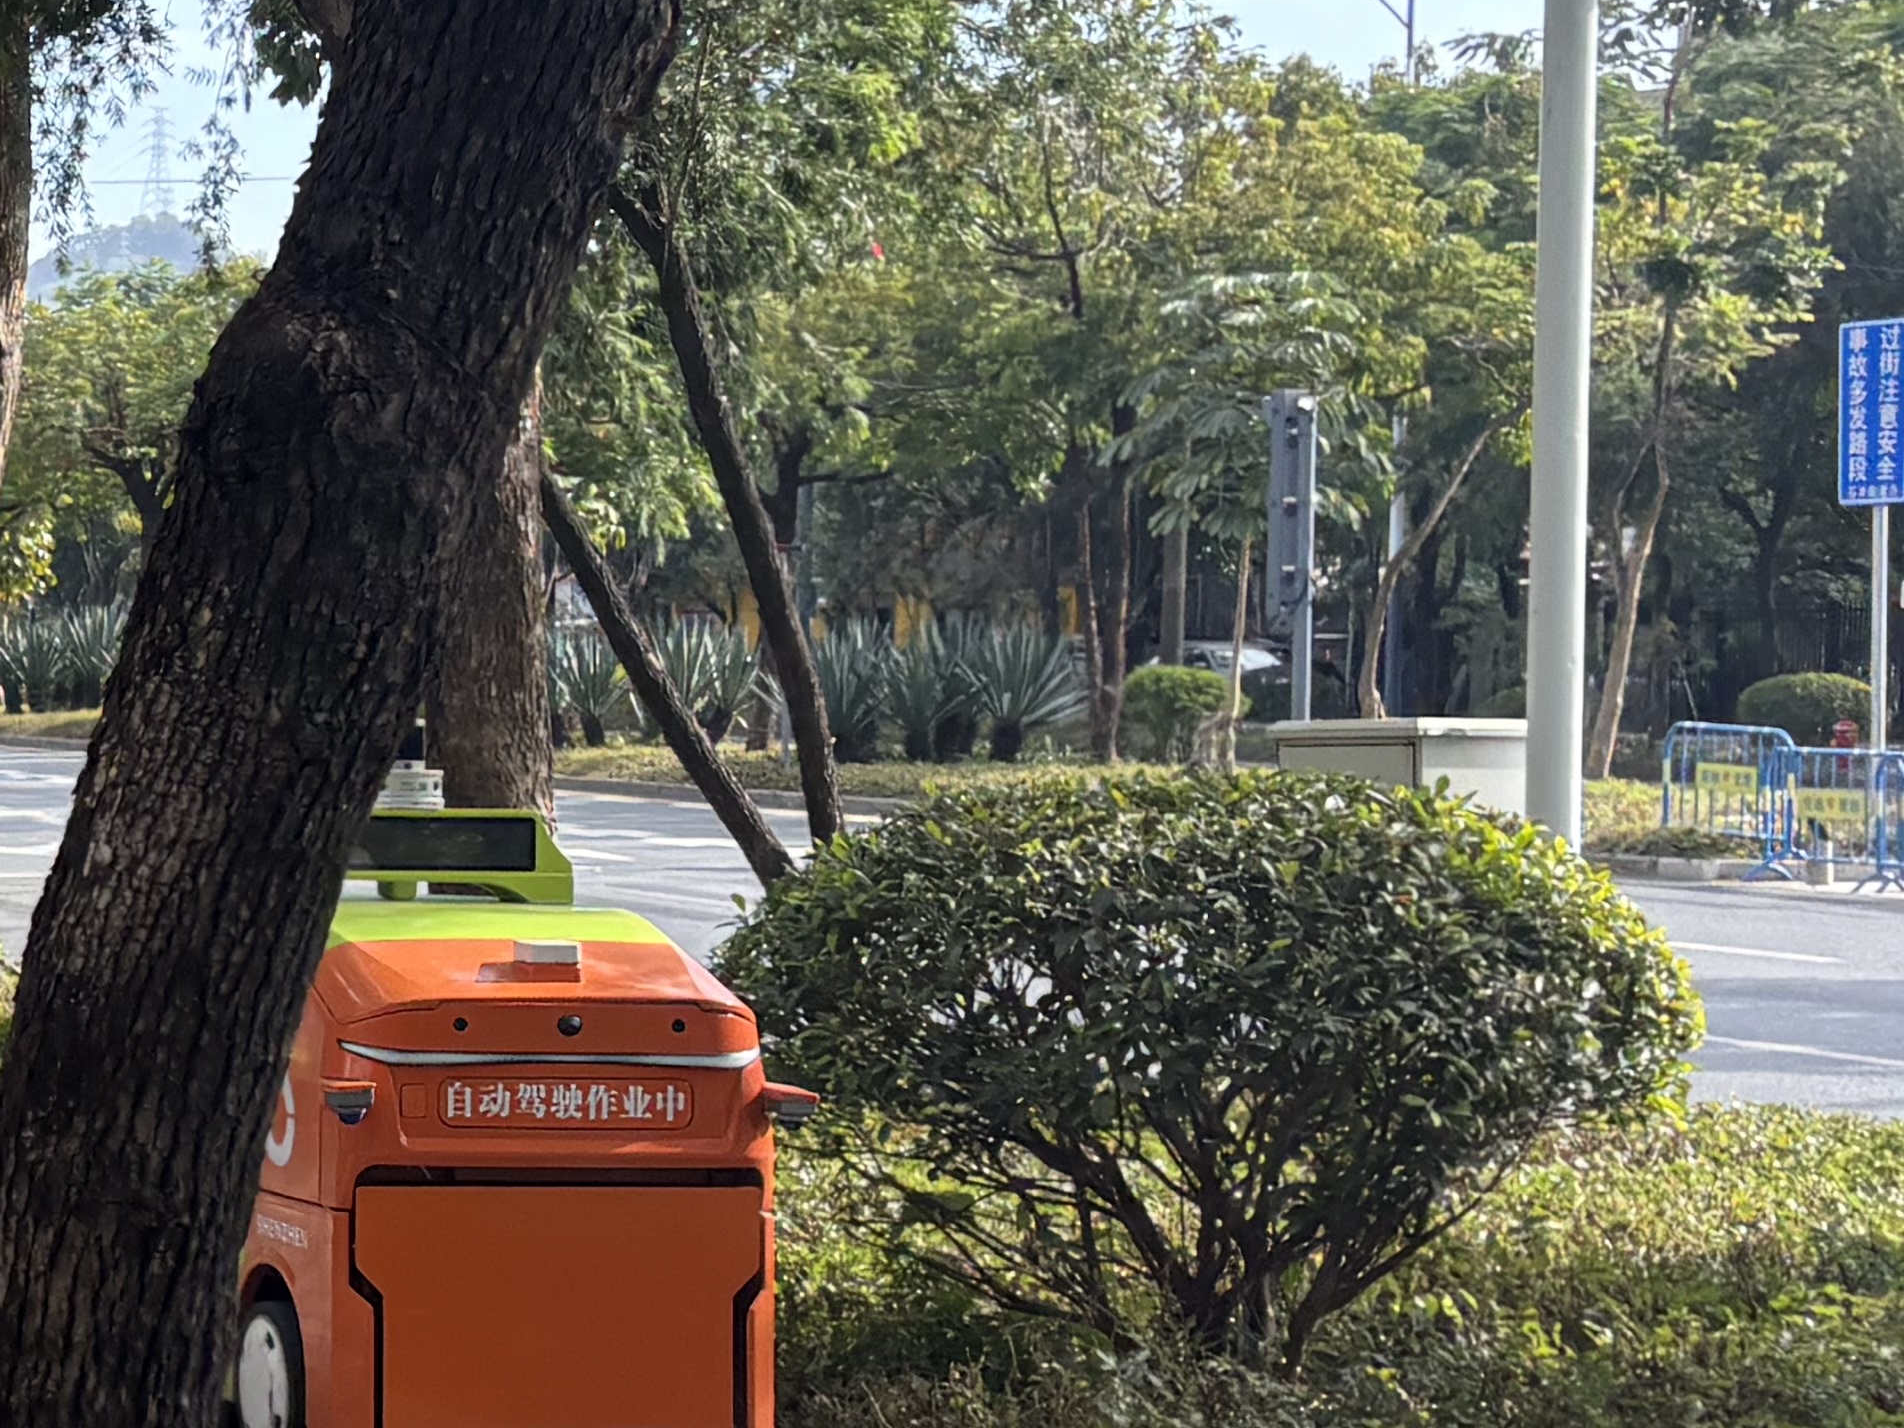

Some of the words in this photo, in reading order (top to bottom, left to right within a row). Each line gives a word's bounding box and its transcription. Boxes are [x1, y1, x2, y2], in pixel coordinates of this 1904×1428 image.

[1848, 327, 1868, 483] 事故多发路段
[1876, 324, 1901, 481] 过街注意安全
[446, 1081, 686, 1122] 自动驾驶作业中
